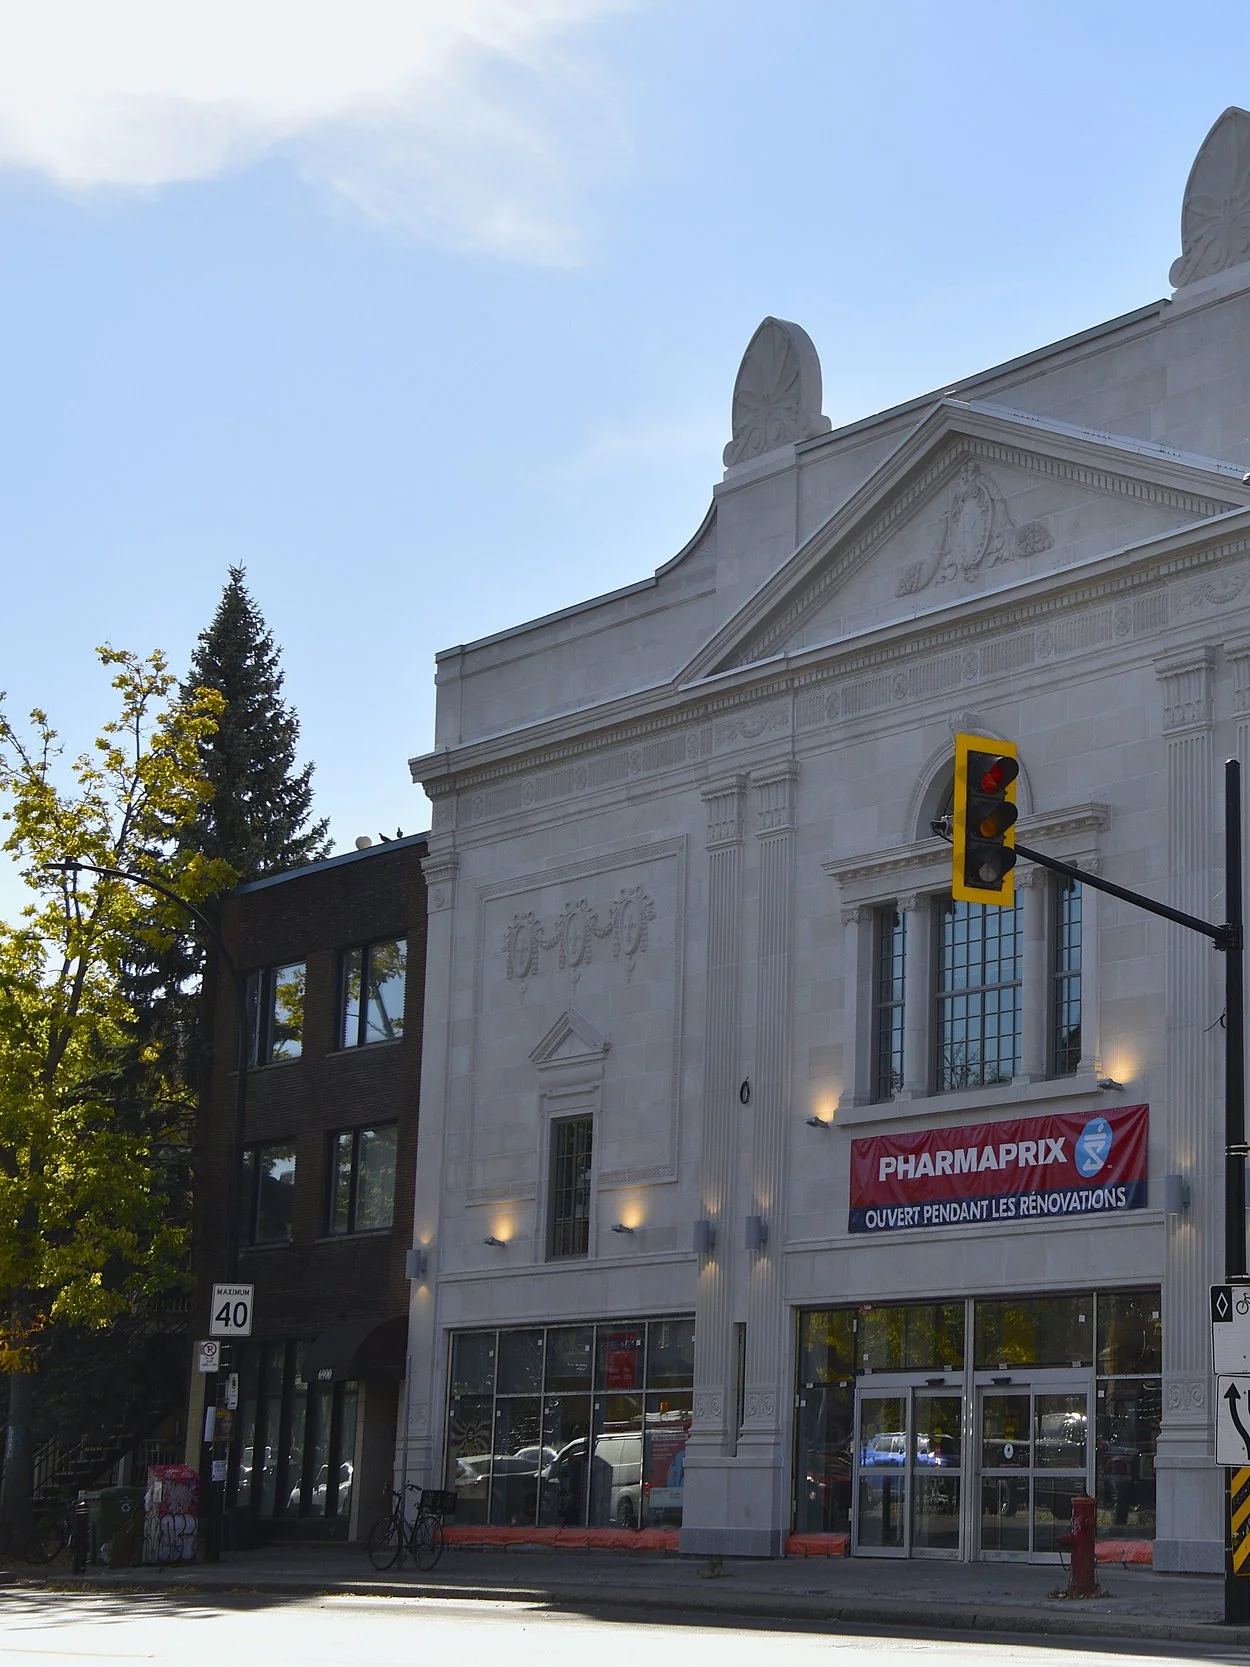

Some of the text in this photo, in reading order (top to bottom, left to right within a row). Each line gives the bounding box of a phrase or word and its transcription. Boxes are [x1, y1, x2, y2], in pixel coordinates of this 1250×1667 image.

[878, 1136, 1067, 1182] PHARMAPRIX
[865, 1186, 1126, 1229] OUVERT PENDANT LES RÉNOVATIONS
[217, 1288, 250, 1296] MAXIMUM
[215, 1301, 248, 1328] 40
